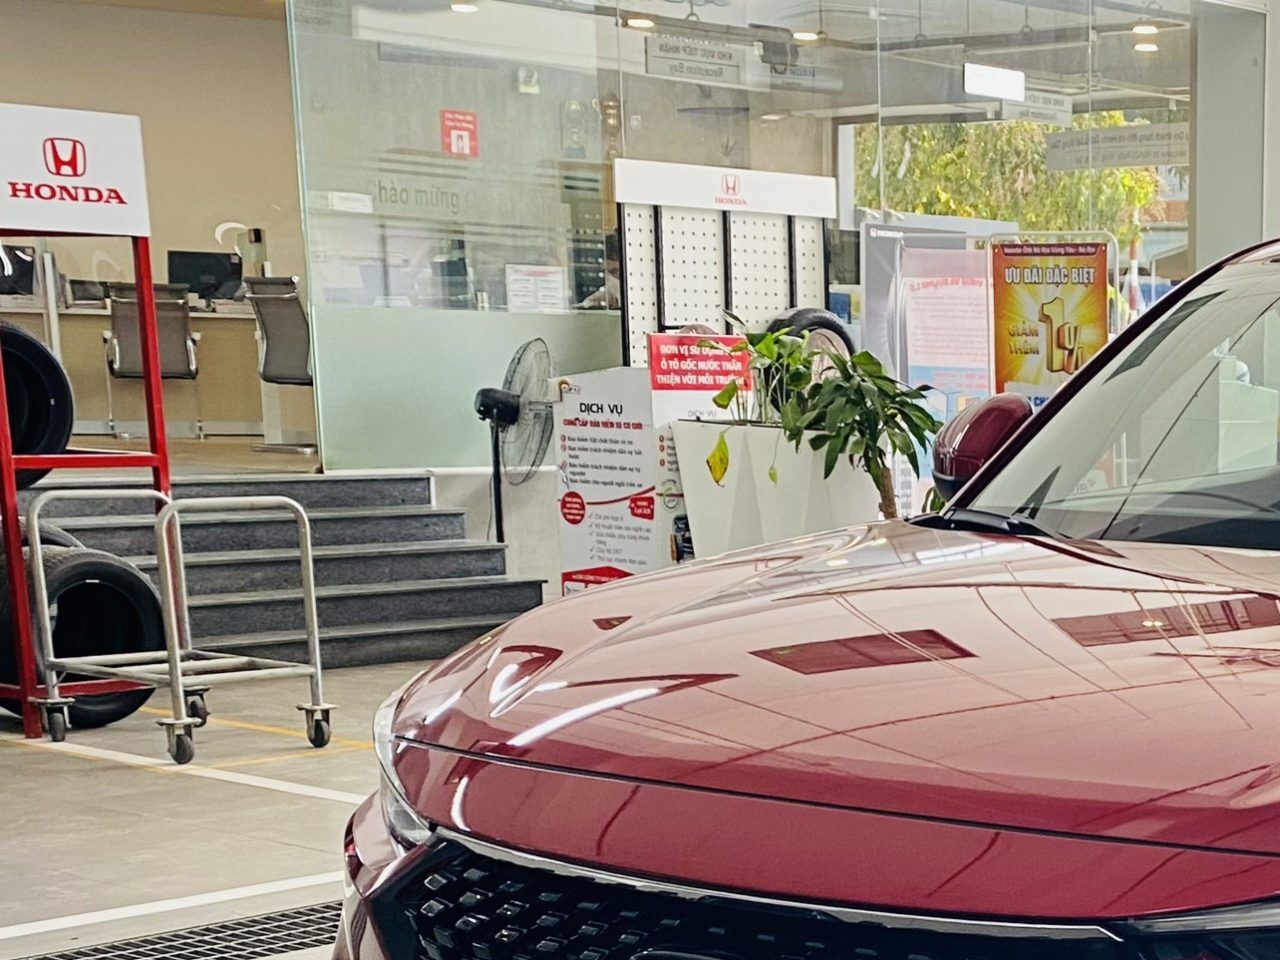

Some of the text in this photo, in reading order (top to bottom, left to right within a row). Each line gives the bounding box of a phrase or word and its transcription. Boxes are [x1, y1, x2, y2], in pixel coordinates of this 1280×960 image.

[7, 181, 127, 205] HONDA
[714, 196, 748, 206] HONDA
[1004, 264, 1096, 288] ƯU ĐÃI ĐẶC BIỆT
[680, 357, 697, 371] GỐC
[698, 357, 720, 371] NƯỚC
[656, 372, 681, 386] THIỆN
[580, 402, 624, 418] DỊCH VỤ
